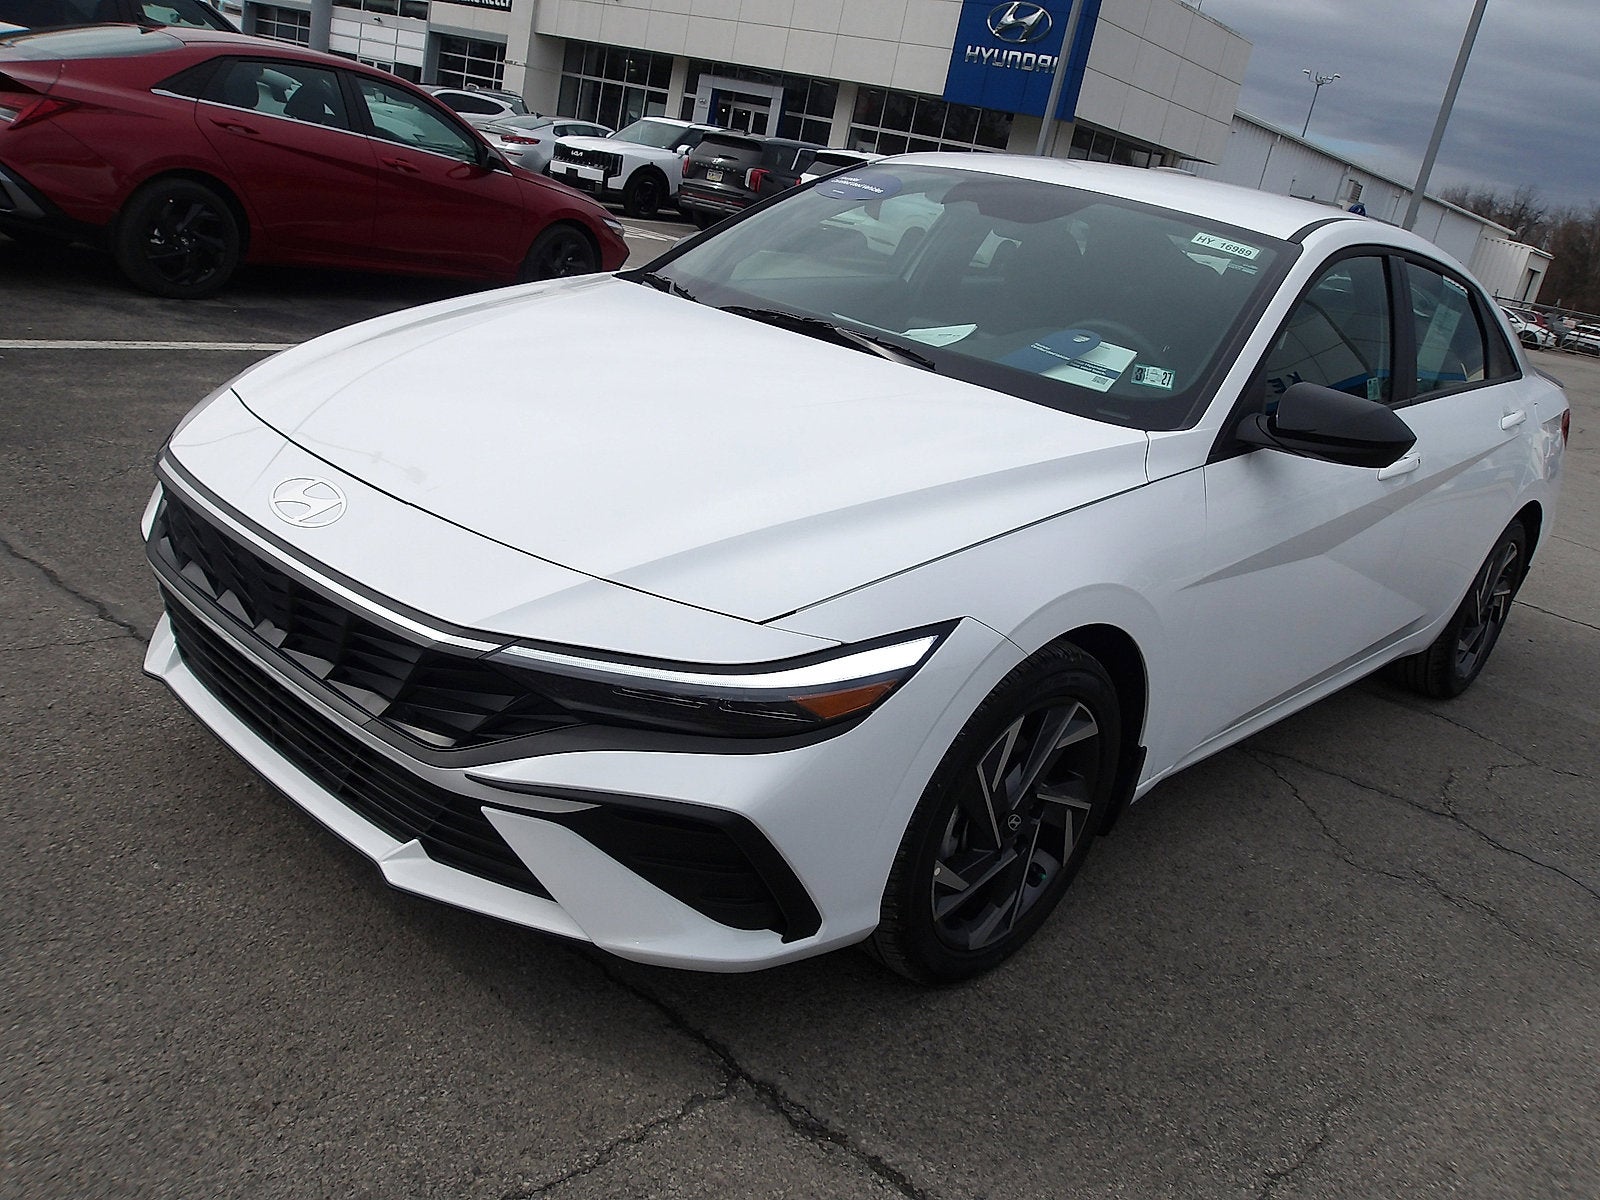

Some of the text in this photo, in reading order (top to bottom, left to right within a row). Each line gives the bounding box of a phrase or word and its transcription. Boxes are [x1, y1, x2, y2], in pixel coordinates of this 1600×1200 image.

[964, 45, 1059, 74] HYUNDAI
[1196, 235, 1252, 257] HY 16989
[1161, 371, 1172, 386] 27
